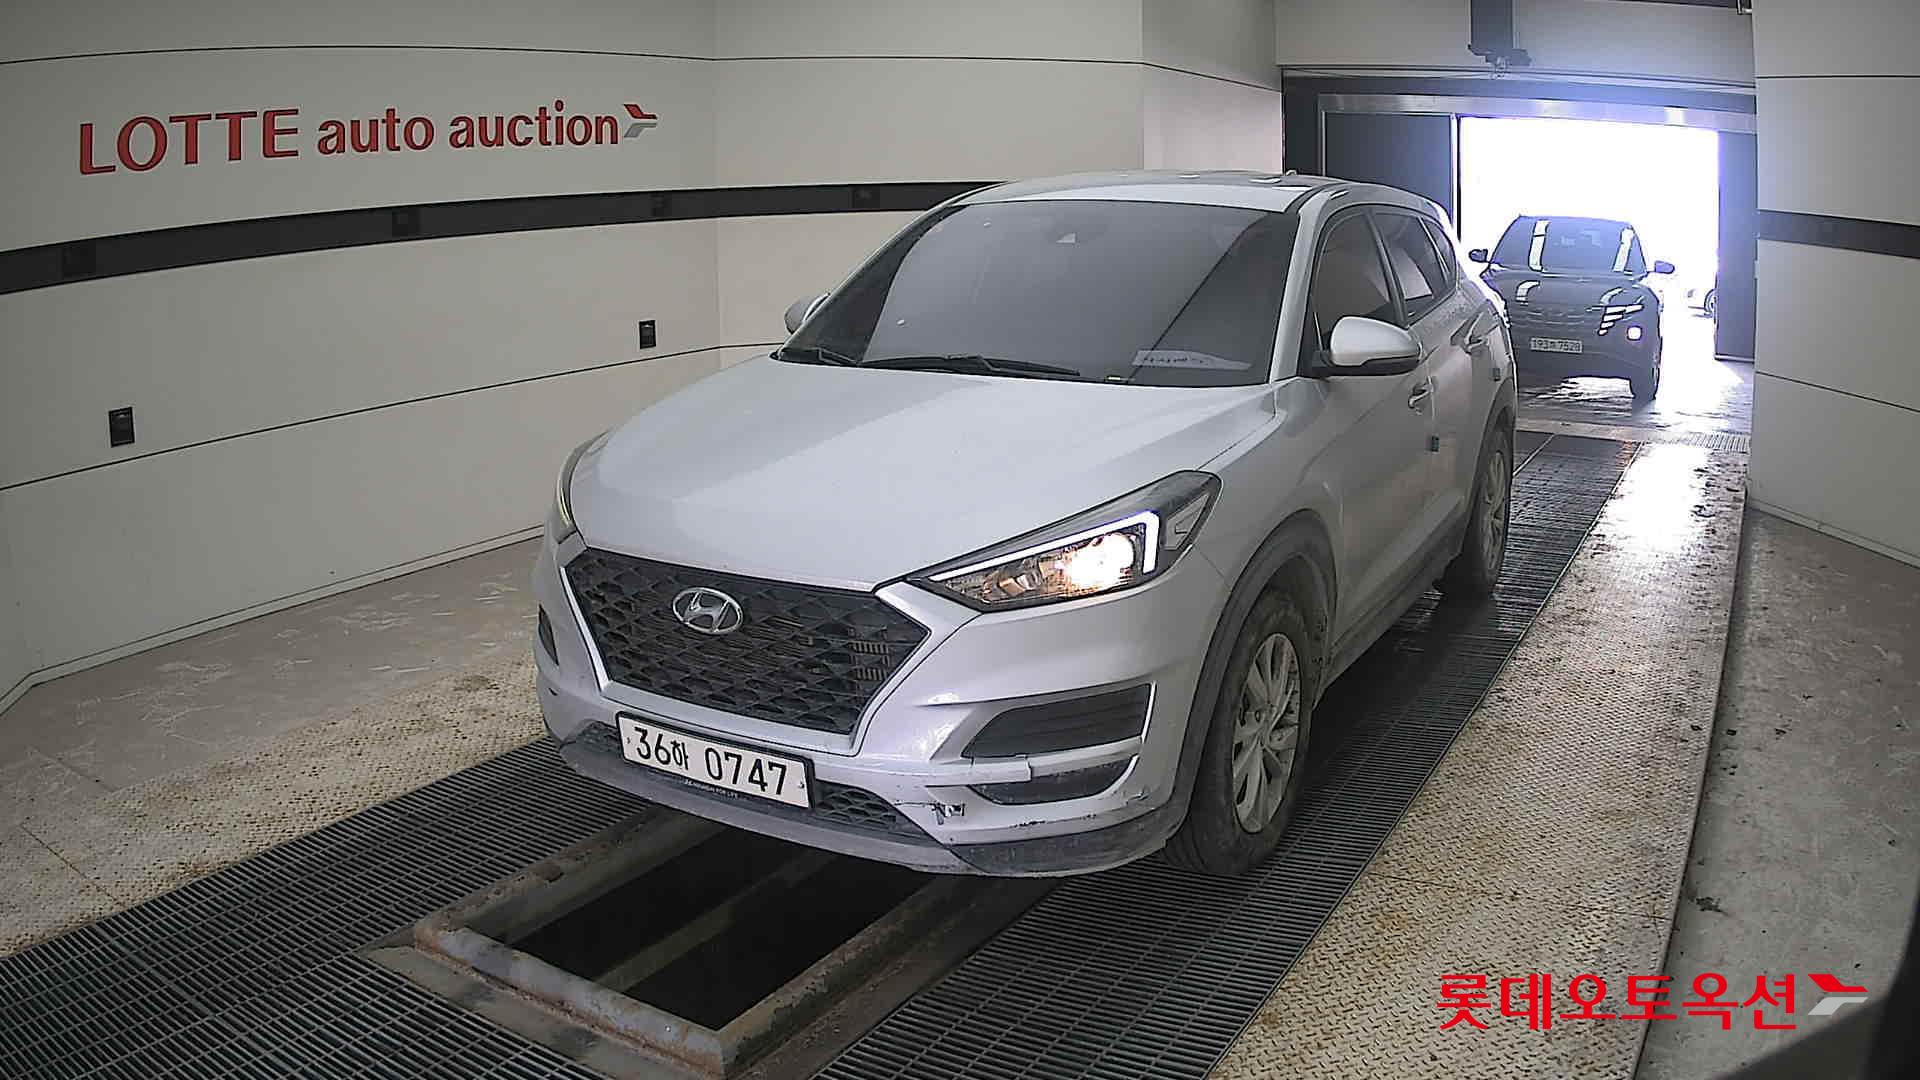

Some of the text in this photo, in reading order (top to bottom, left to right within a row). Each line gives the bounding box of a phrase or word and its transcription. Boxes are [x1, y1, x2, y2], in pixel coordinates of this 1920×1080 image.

[80, 100, 619, 175] LOTTE auto auction
[634, 726, 787, 796] 36하 0747
